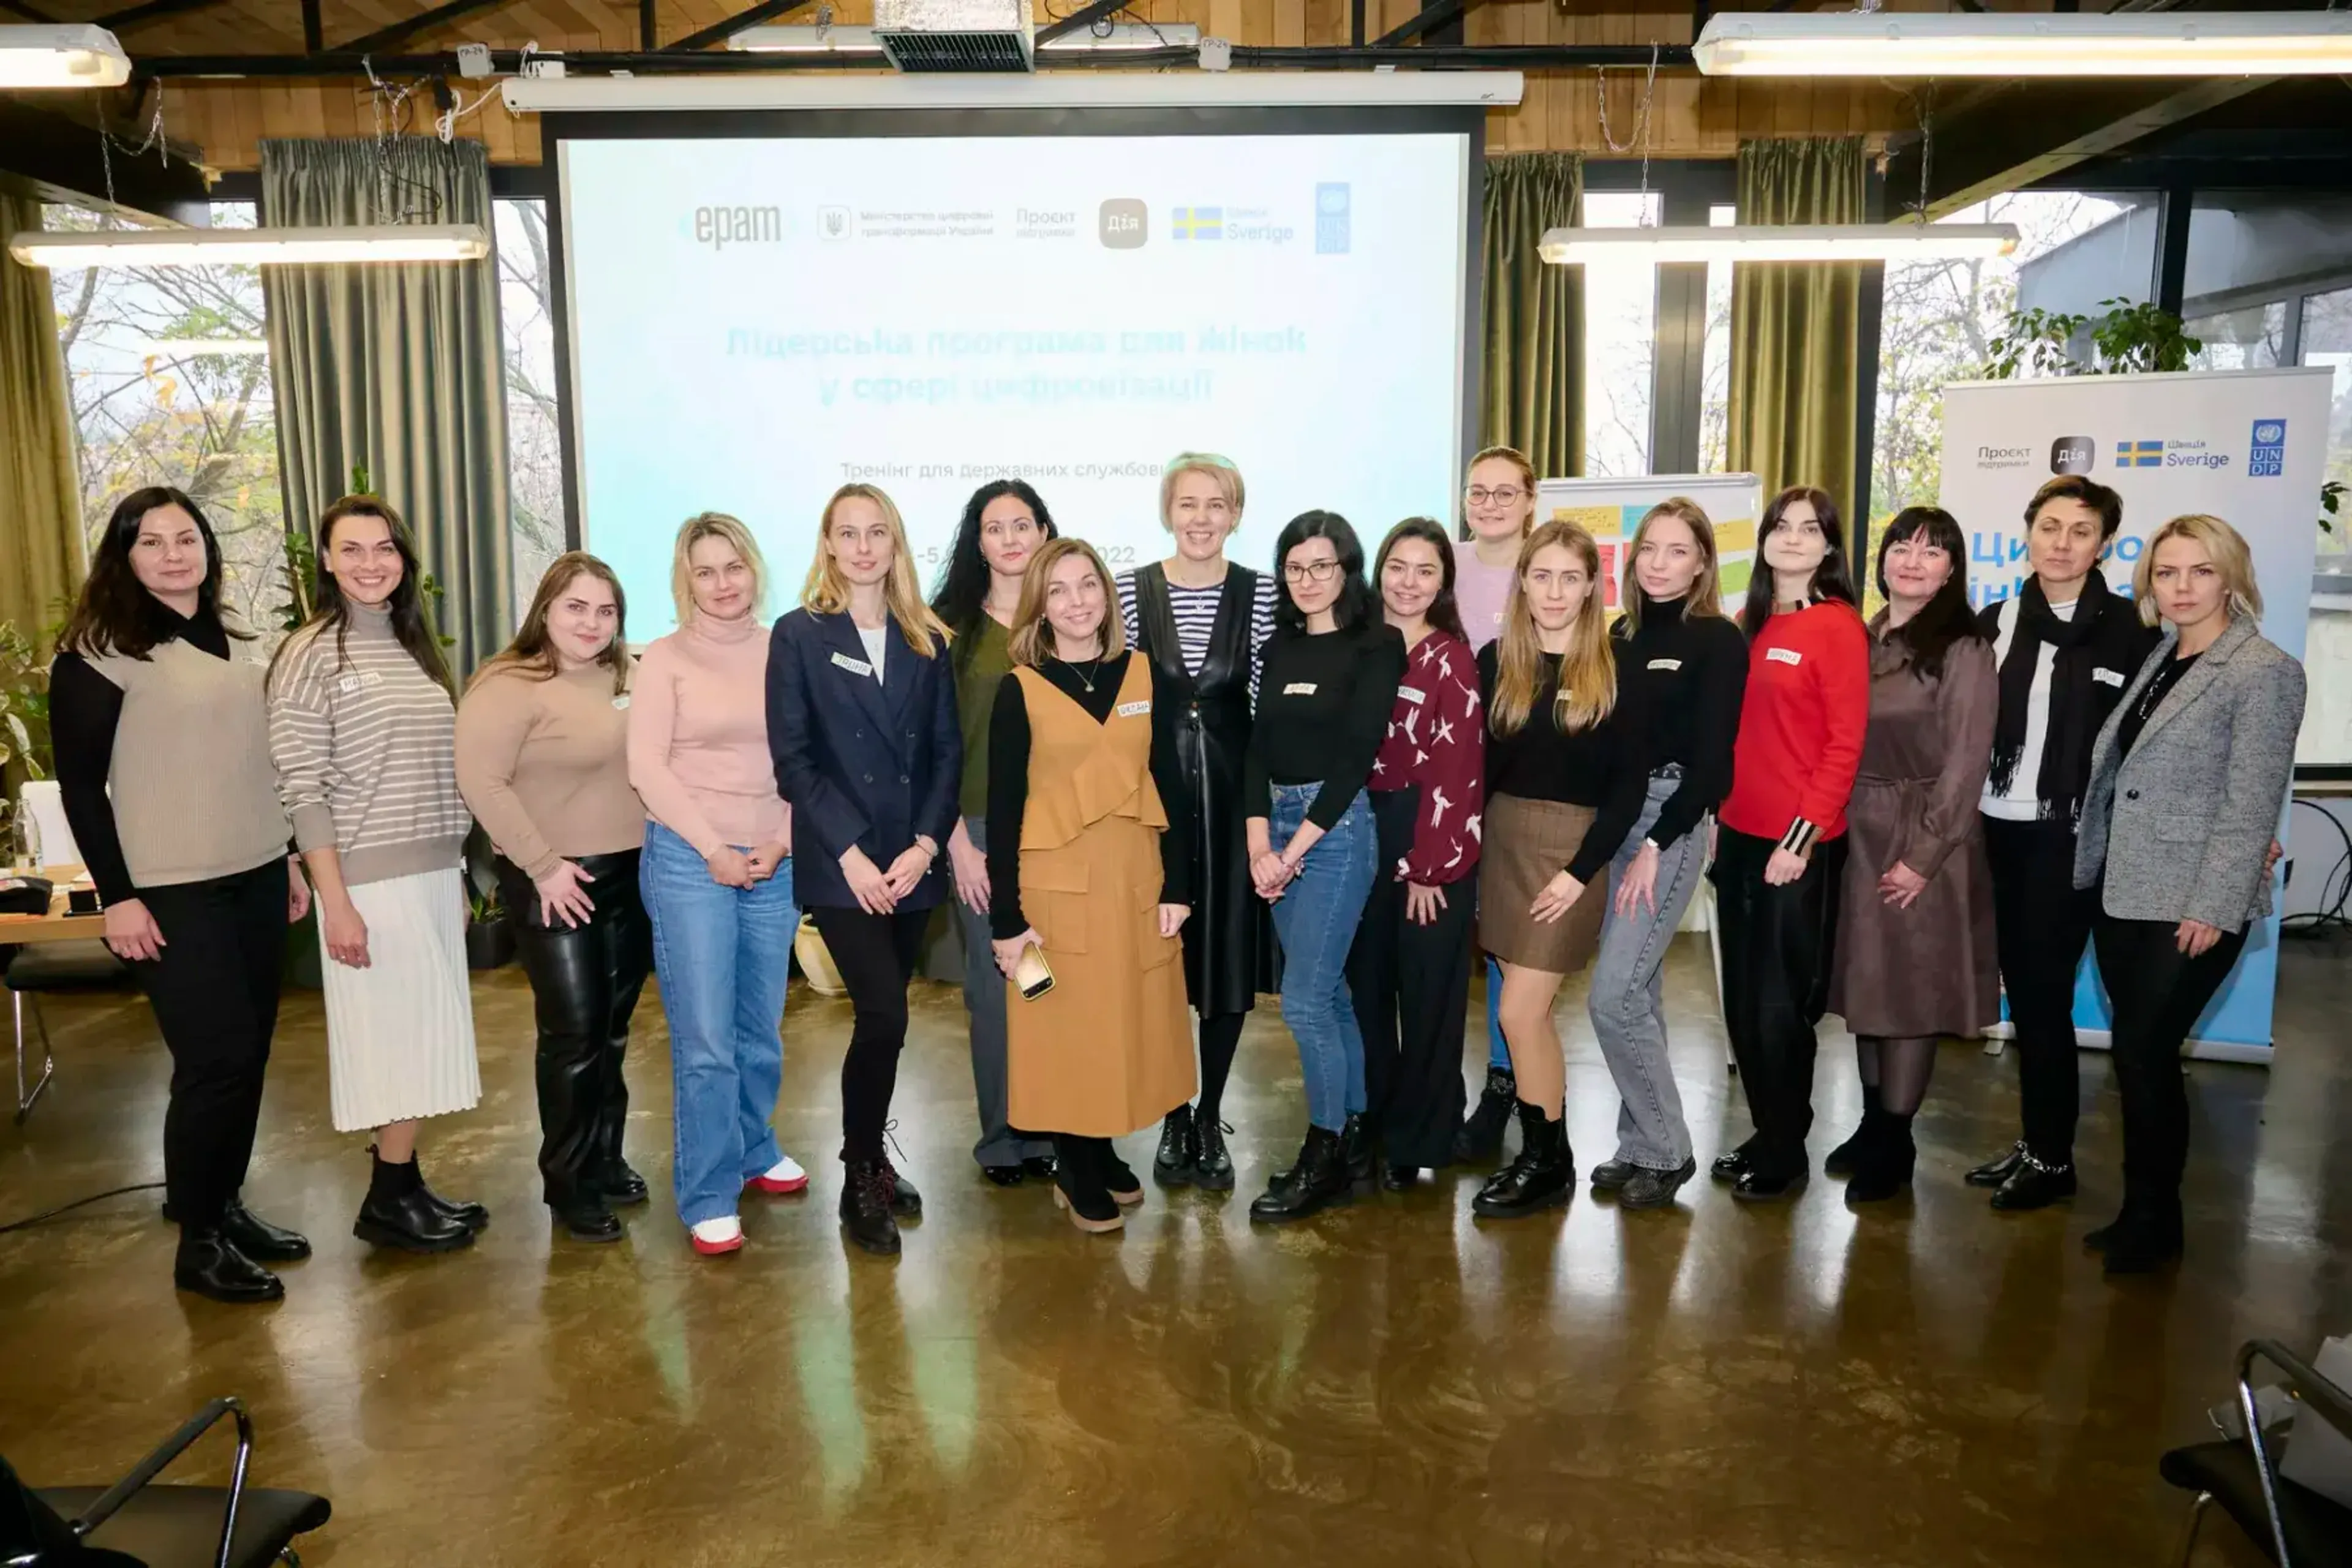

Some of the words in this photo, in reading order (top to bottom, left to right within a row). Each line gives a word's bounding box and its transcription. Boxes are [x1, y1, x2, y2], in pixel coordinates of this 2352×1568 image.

[1016, 208, 1076, 227] Проєкт
[1108, 213, 1139, 233] Дія
[696, 206, 781, 251] epam
[1228, 223, 1293, 244] Sverige
[726, 327, 913, 359] Лідерська
[927, 330, 1106, 359] програма
[1197, 325, 1307, 355] жінок
[819, 377, 840, 406] у
[852, 374, 957, 404] сфері
[1978, 446, 2032, 460] Проєкт
[2058, 447, 2086, 464] Дія
[2167, 452, 2230, 469] Sverige
[842, 462, 913, 480] Тренінг
[919, 465, 954, 479] для
[960, 464, 1068, 480] державних
